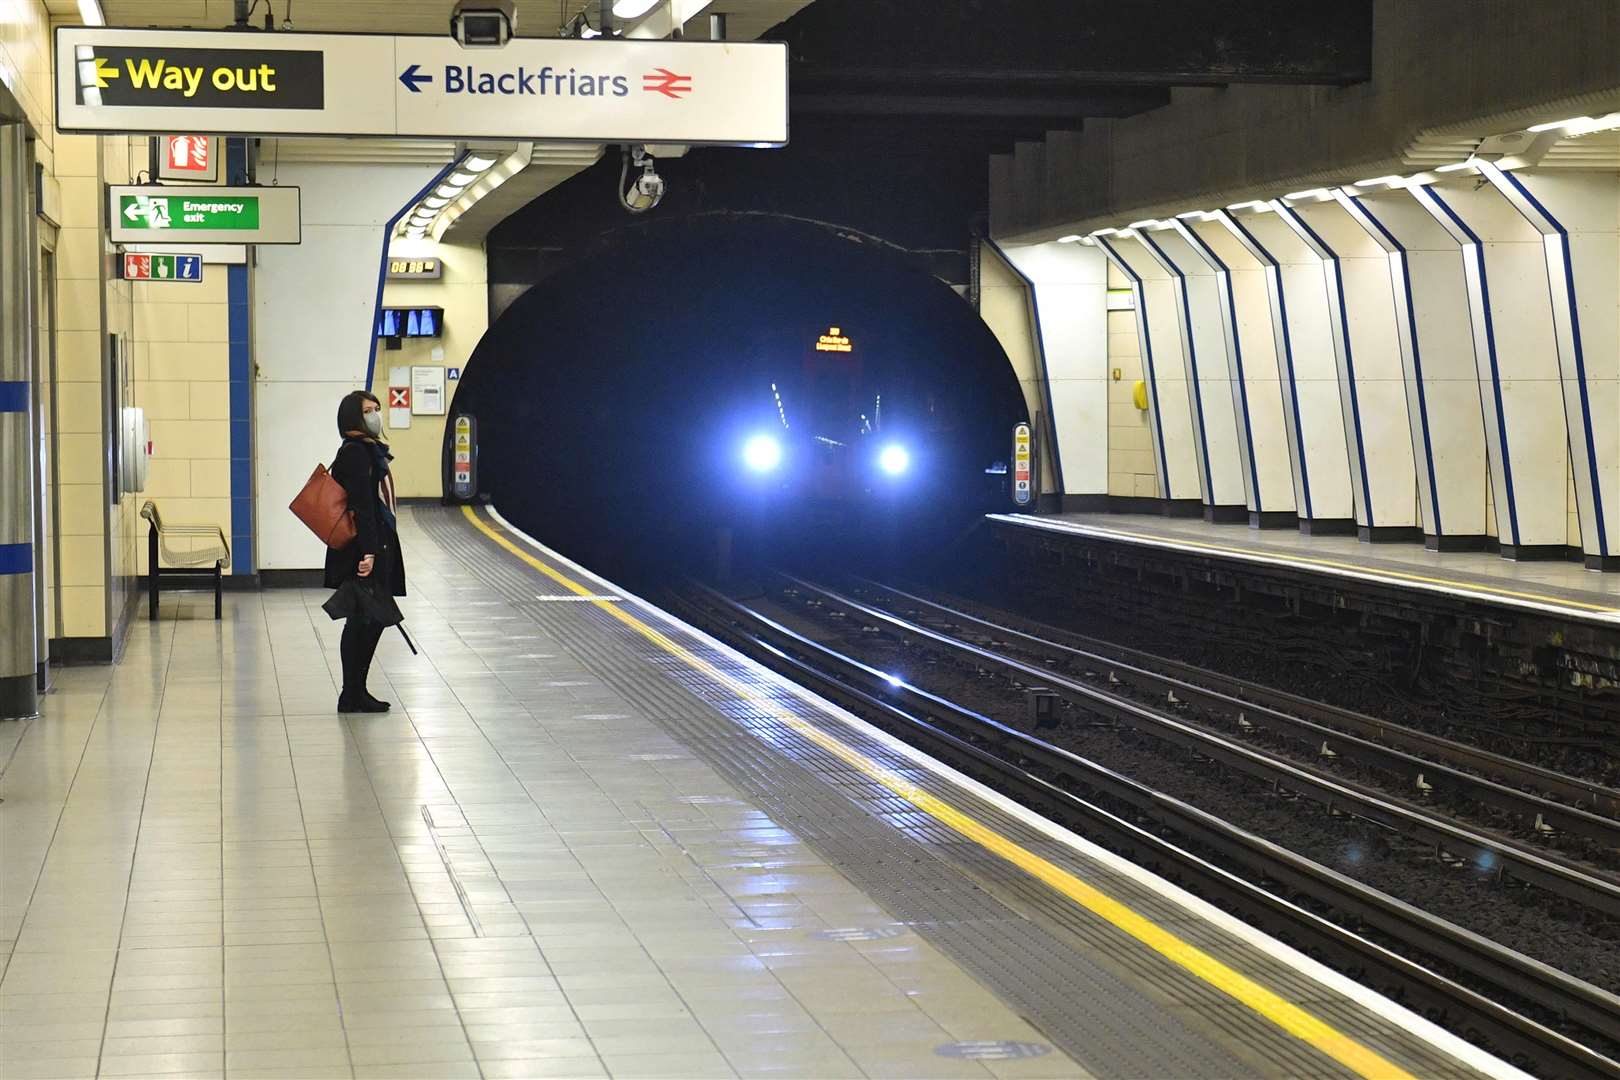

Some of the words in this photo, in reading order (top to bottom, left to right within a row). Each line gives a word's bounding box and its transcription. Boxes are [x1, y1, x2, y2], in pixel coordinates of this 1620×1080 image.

[125, 58, 203, 98] Way
[211, 64, 276, 92] out
[445, 65, 629, 97] Blackfriars
[183, 201, 244, 214] Emergency
[183, 213, 205, 223] exit
